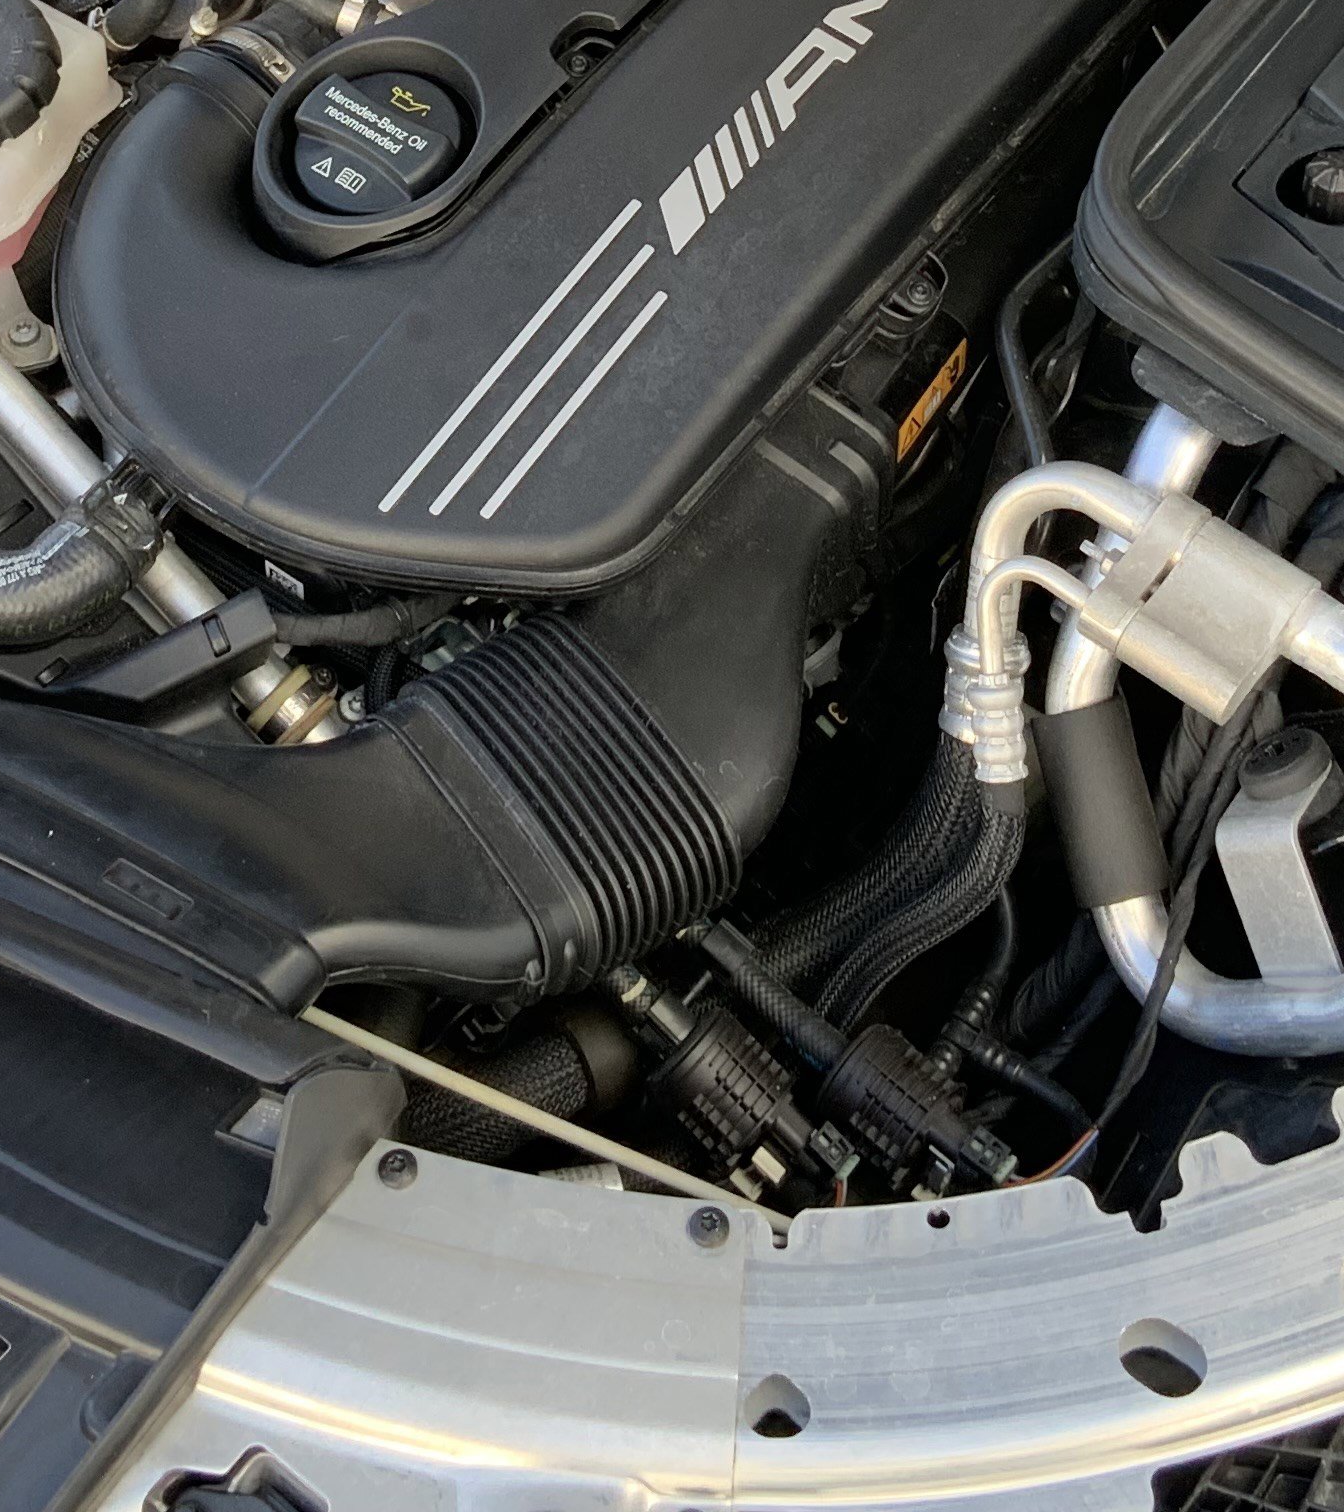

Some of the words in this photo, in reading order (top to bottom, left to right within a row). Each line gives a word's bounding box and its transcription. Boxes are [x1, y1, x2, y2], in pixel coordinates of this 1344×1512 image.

[324, 86, 409, 141] Mercedes-Benz
[407, 135, 428, 152] Oil
[324, 105, 403, 155] recommended
